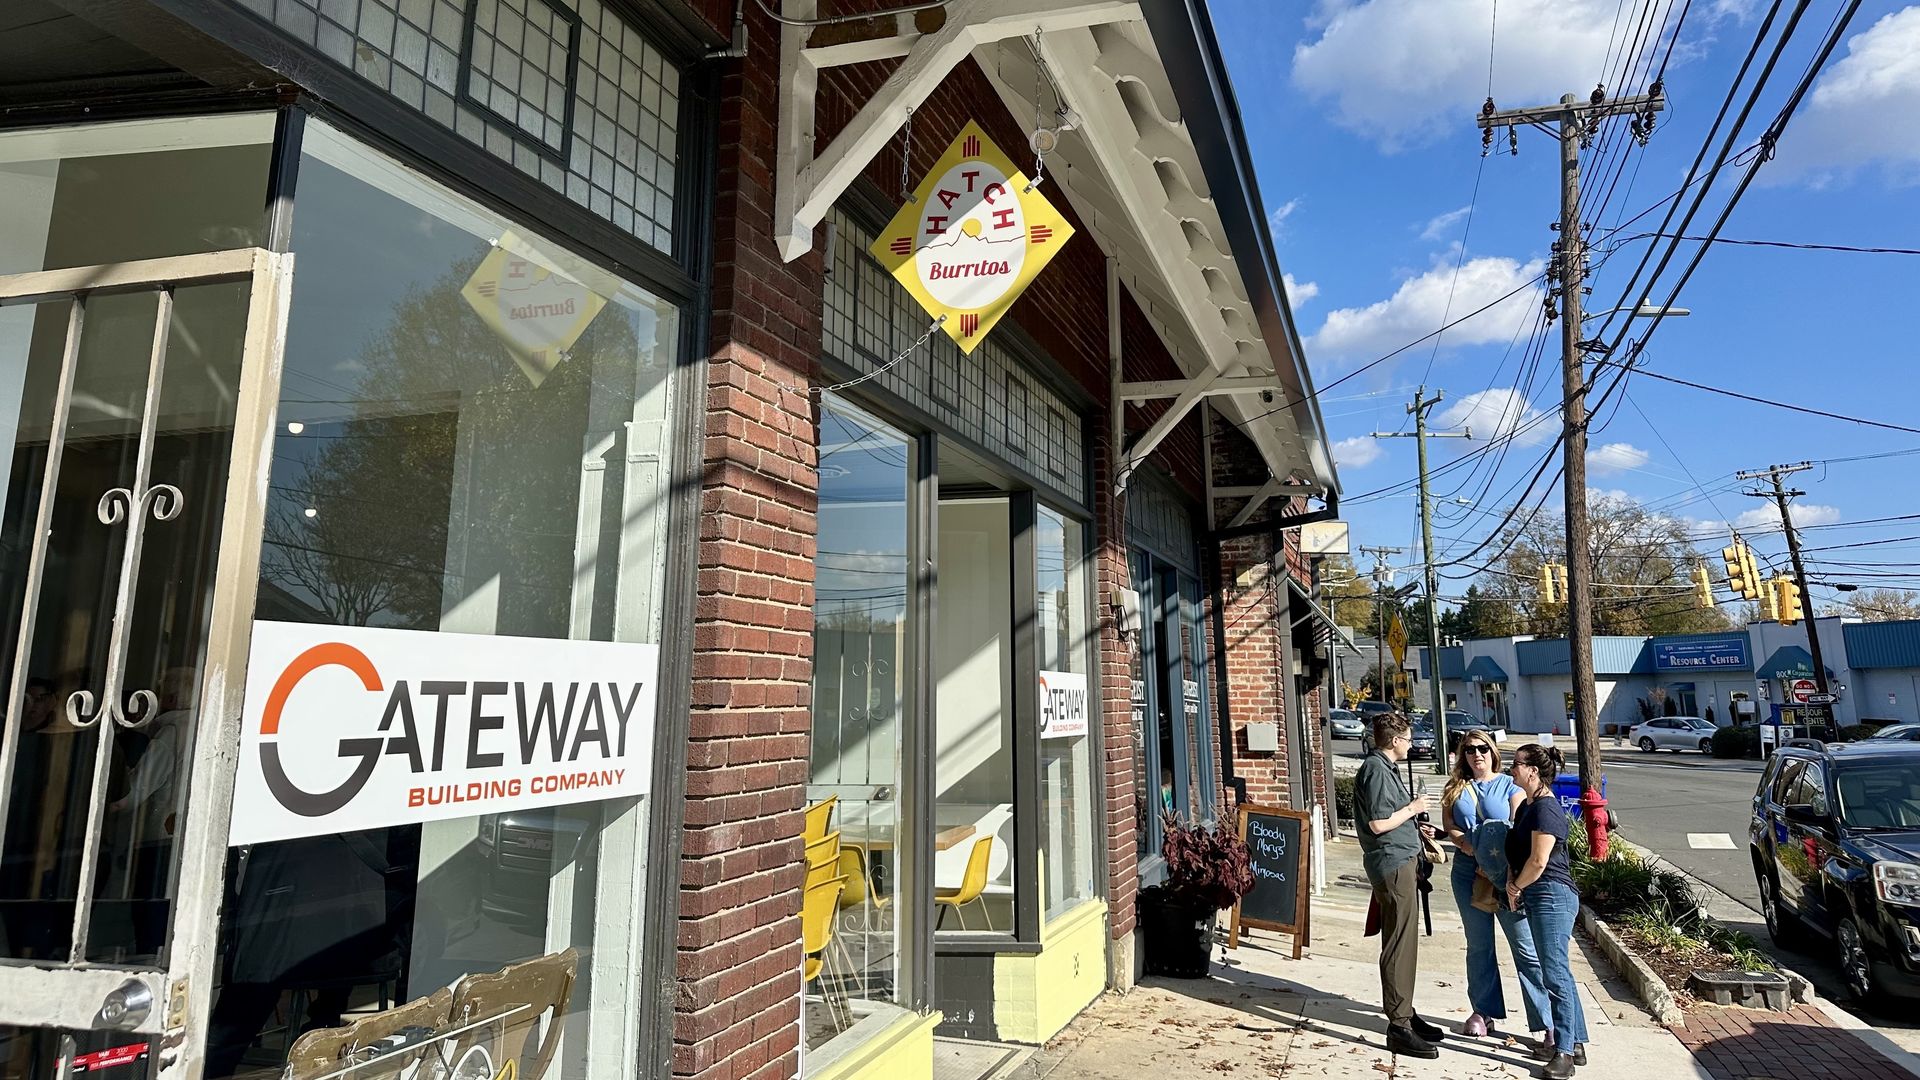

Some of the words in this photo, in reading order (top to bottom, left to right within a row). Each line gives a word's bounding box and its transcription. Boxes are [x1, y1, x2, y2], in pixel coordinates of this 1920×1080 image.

[926, 171, 1015, 234] HATCH
[929, 259, 1012, 280] Burritos
[1670, 656, 1707, 666] RESOURCE
[1710, 654, 1740, 665] CENTER
[1797, 709, 1823, 717] RESOUR
[1803, 717, 1825, 725] CENTE
[259, 641, 644, 818] GATEWAY
[408, 778, 522, 808] BUILDING
[531, 768, 626, 795] COMPANY
[1249, 821, 1286, 847] Bloody
[1249, 860, 1286, 881] Mimosas
